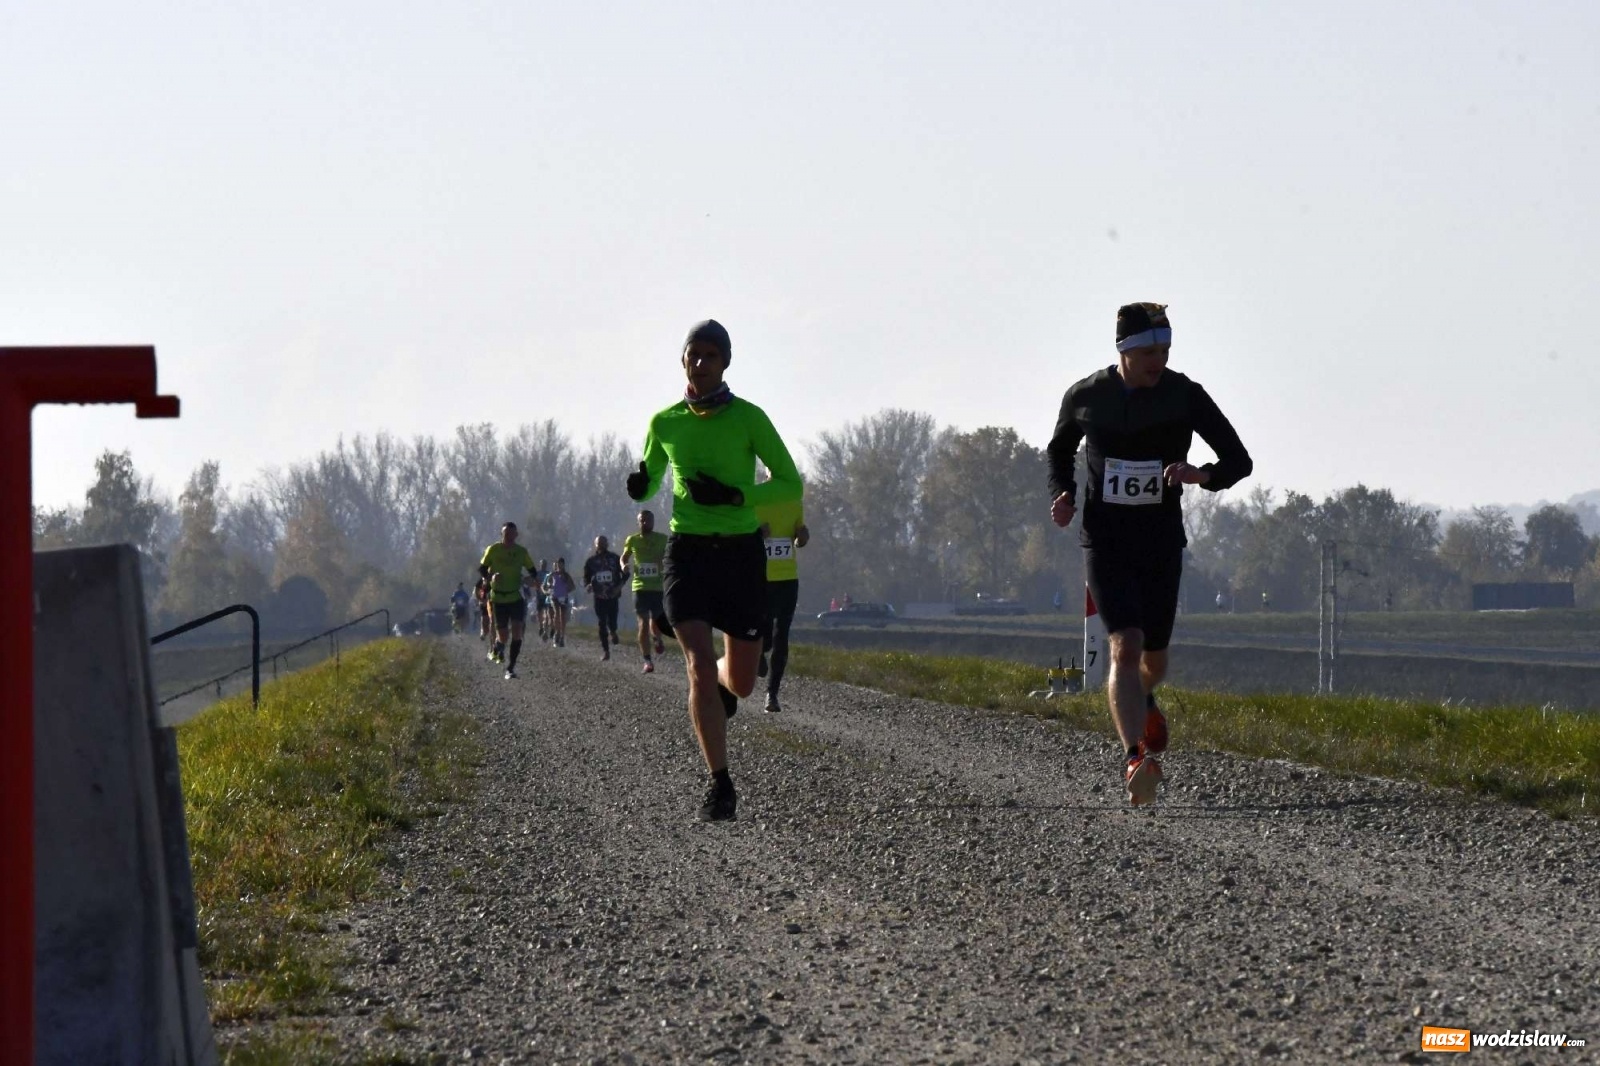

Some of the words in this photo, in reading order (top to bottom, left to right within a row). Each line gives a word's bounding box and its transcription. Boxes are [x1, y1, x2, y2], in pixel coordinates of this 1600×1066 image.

[1108, 475, 1160, 497] 164
[766, 545, 791, 556] 157
[1088, 651, 1097, 667] 7
